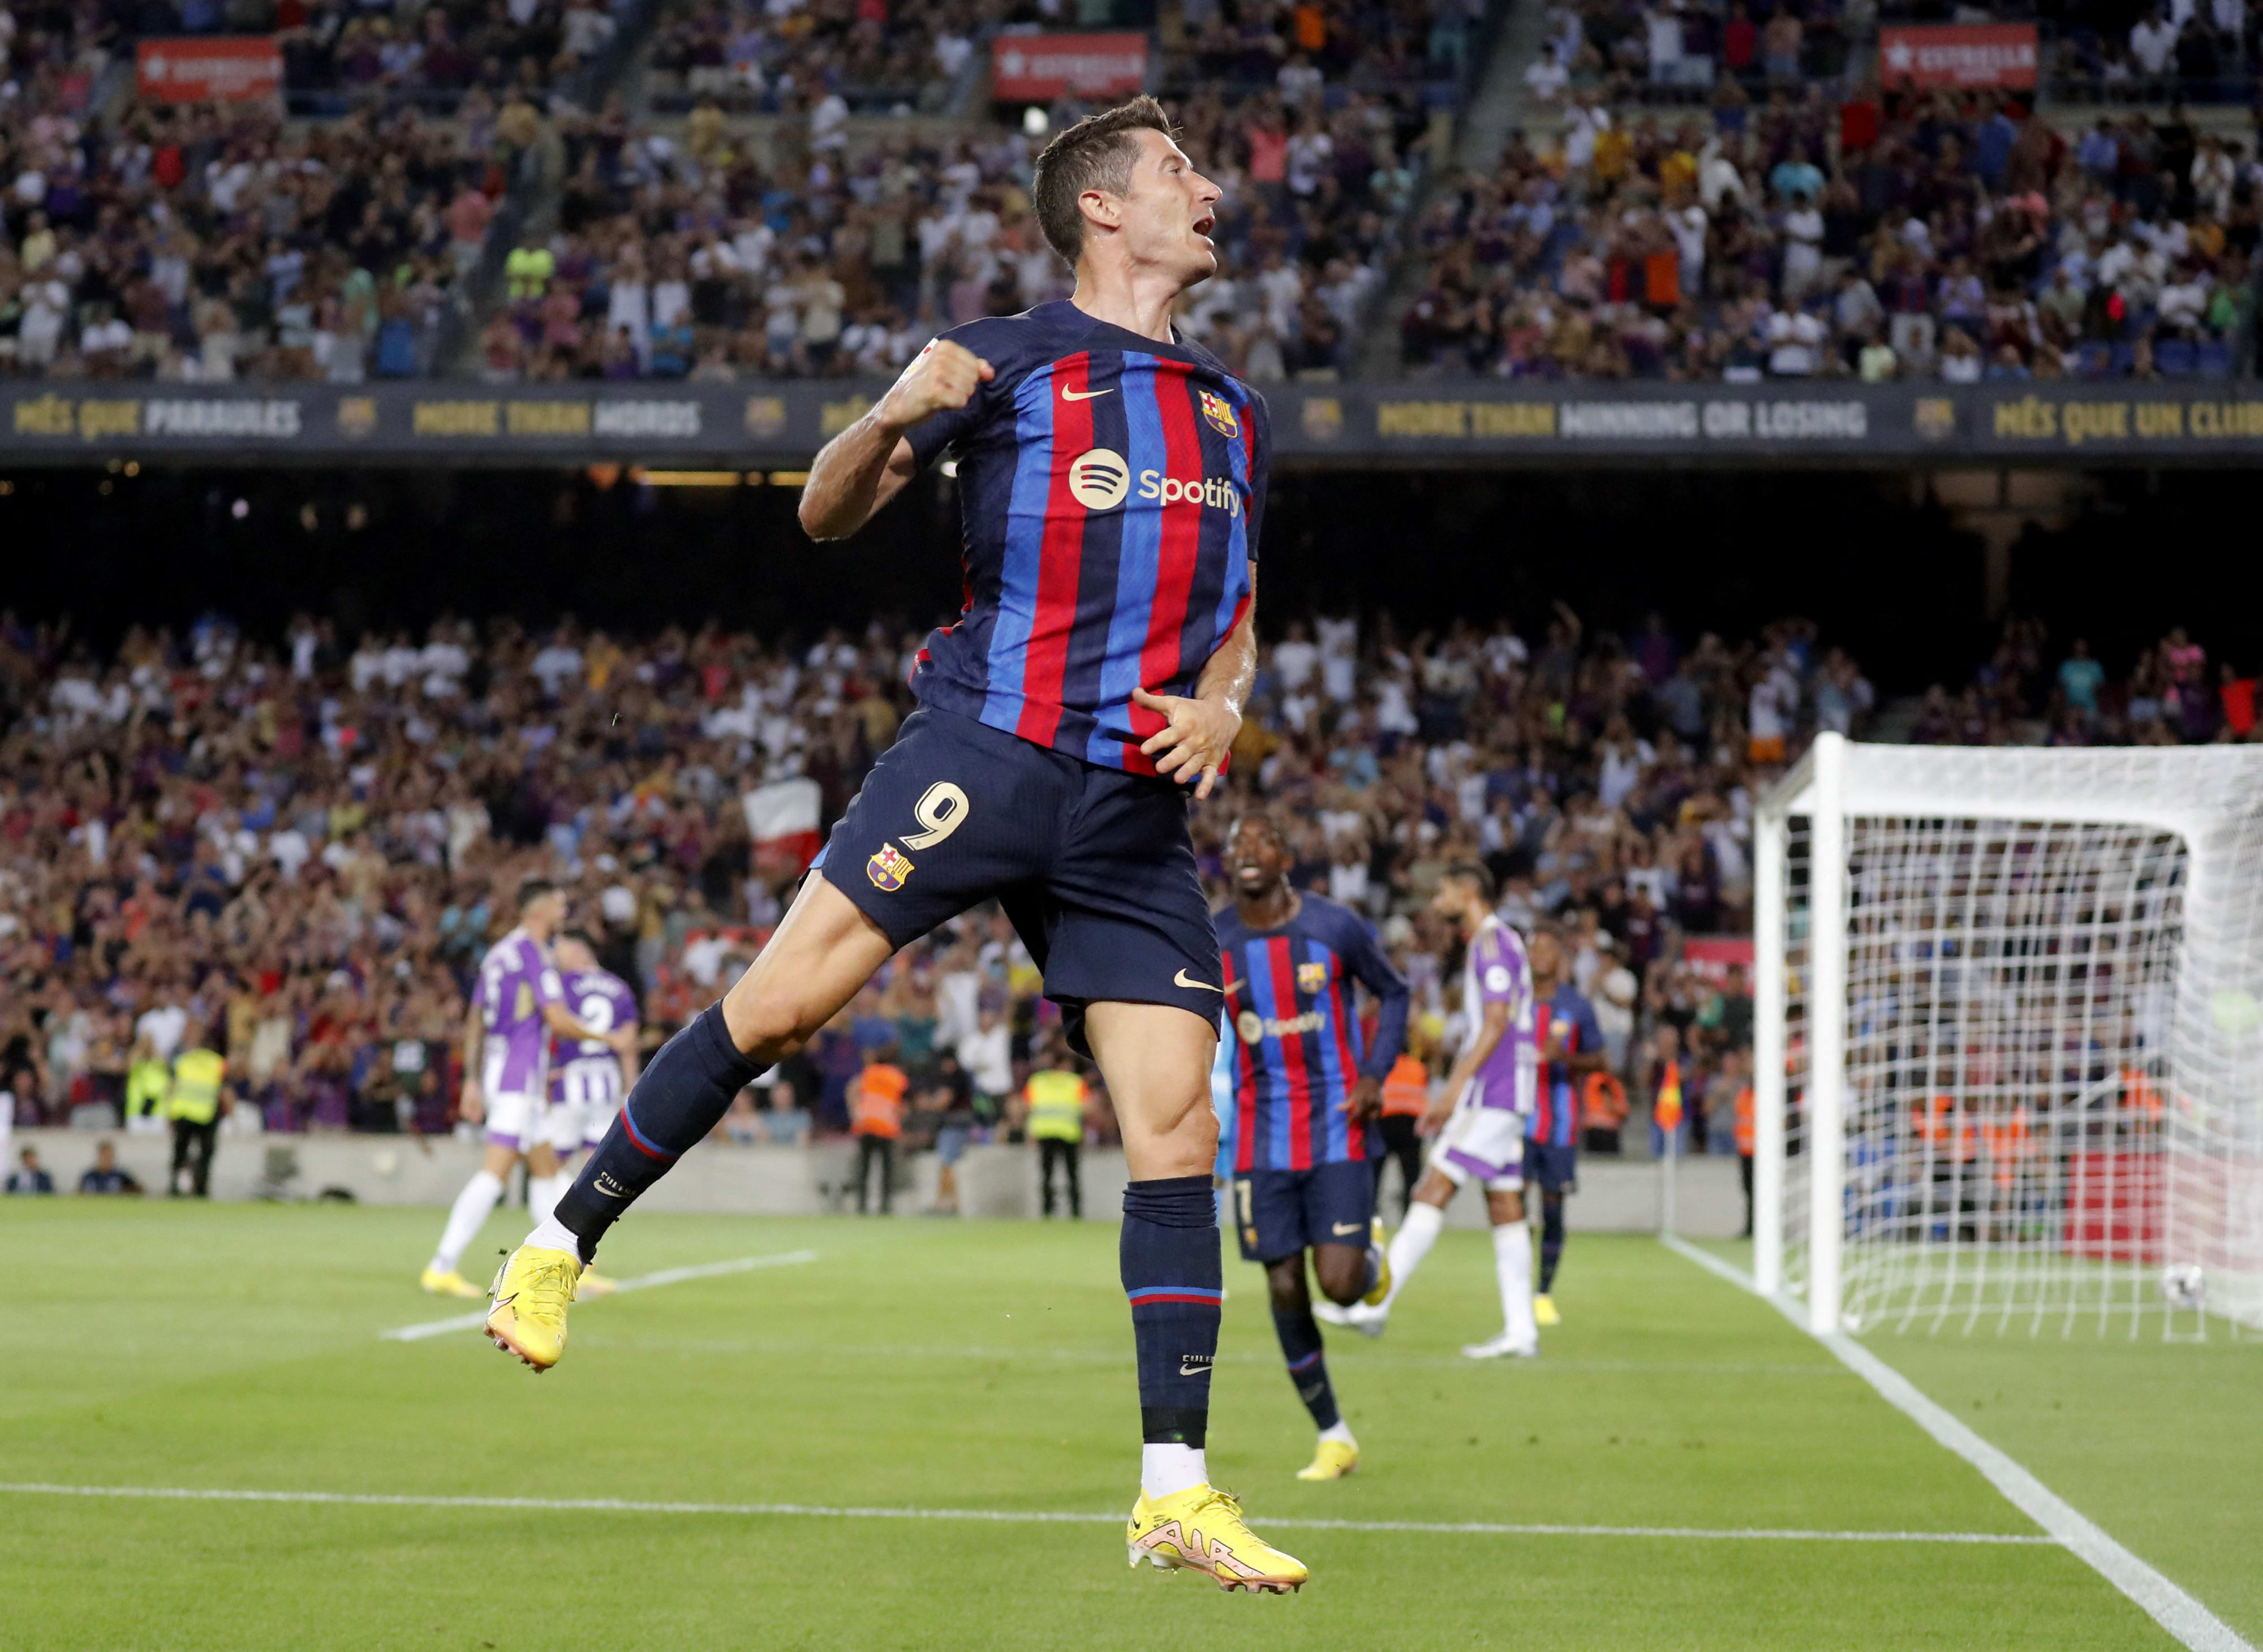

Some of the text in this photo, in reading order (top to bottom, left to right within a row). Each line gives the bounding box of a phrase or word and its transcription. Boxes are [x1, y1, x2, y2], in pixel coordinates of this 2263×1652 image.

[1703, 401, 1749, 438] OR
[1757, 401, 1866, 438] LOSING
[2062, 402, 2128, 445] QUE
[2136, 402, 2183, 437] UN
[1138, 469, 1240, 518] Spotify
[898, 781, 970, 851] 9
